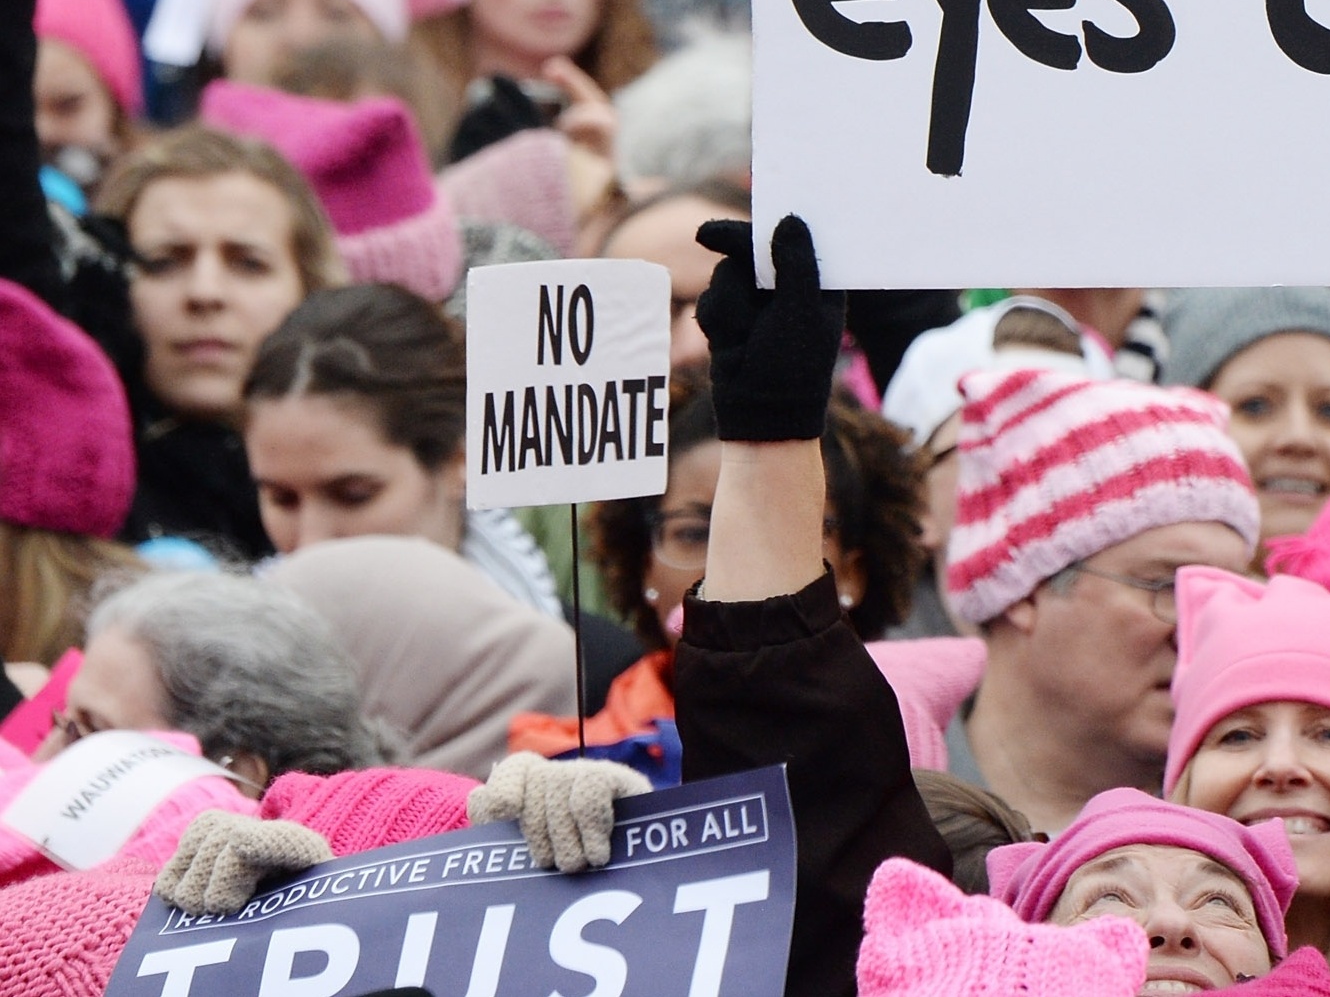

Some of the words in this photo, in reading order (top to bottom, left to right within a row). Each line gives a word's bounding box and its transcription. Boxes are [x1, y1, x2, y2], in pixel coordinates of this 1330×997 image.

[537, 283, 594, 366] NO
[481, 375, 666, 475] MANDATE
[174, 857, 426, 929] RERODUCTIVE
[442, 846, 541, 878] FREE
[626, 817, 689, 857] FOR
[701, 804, 758, 844] ALL
